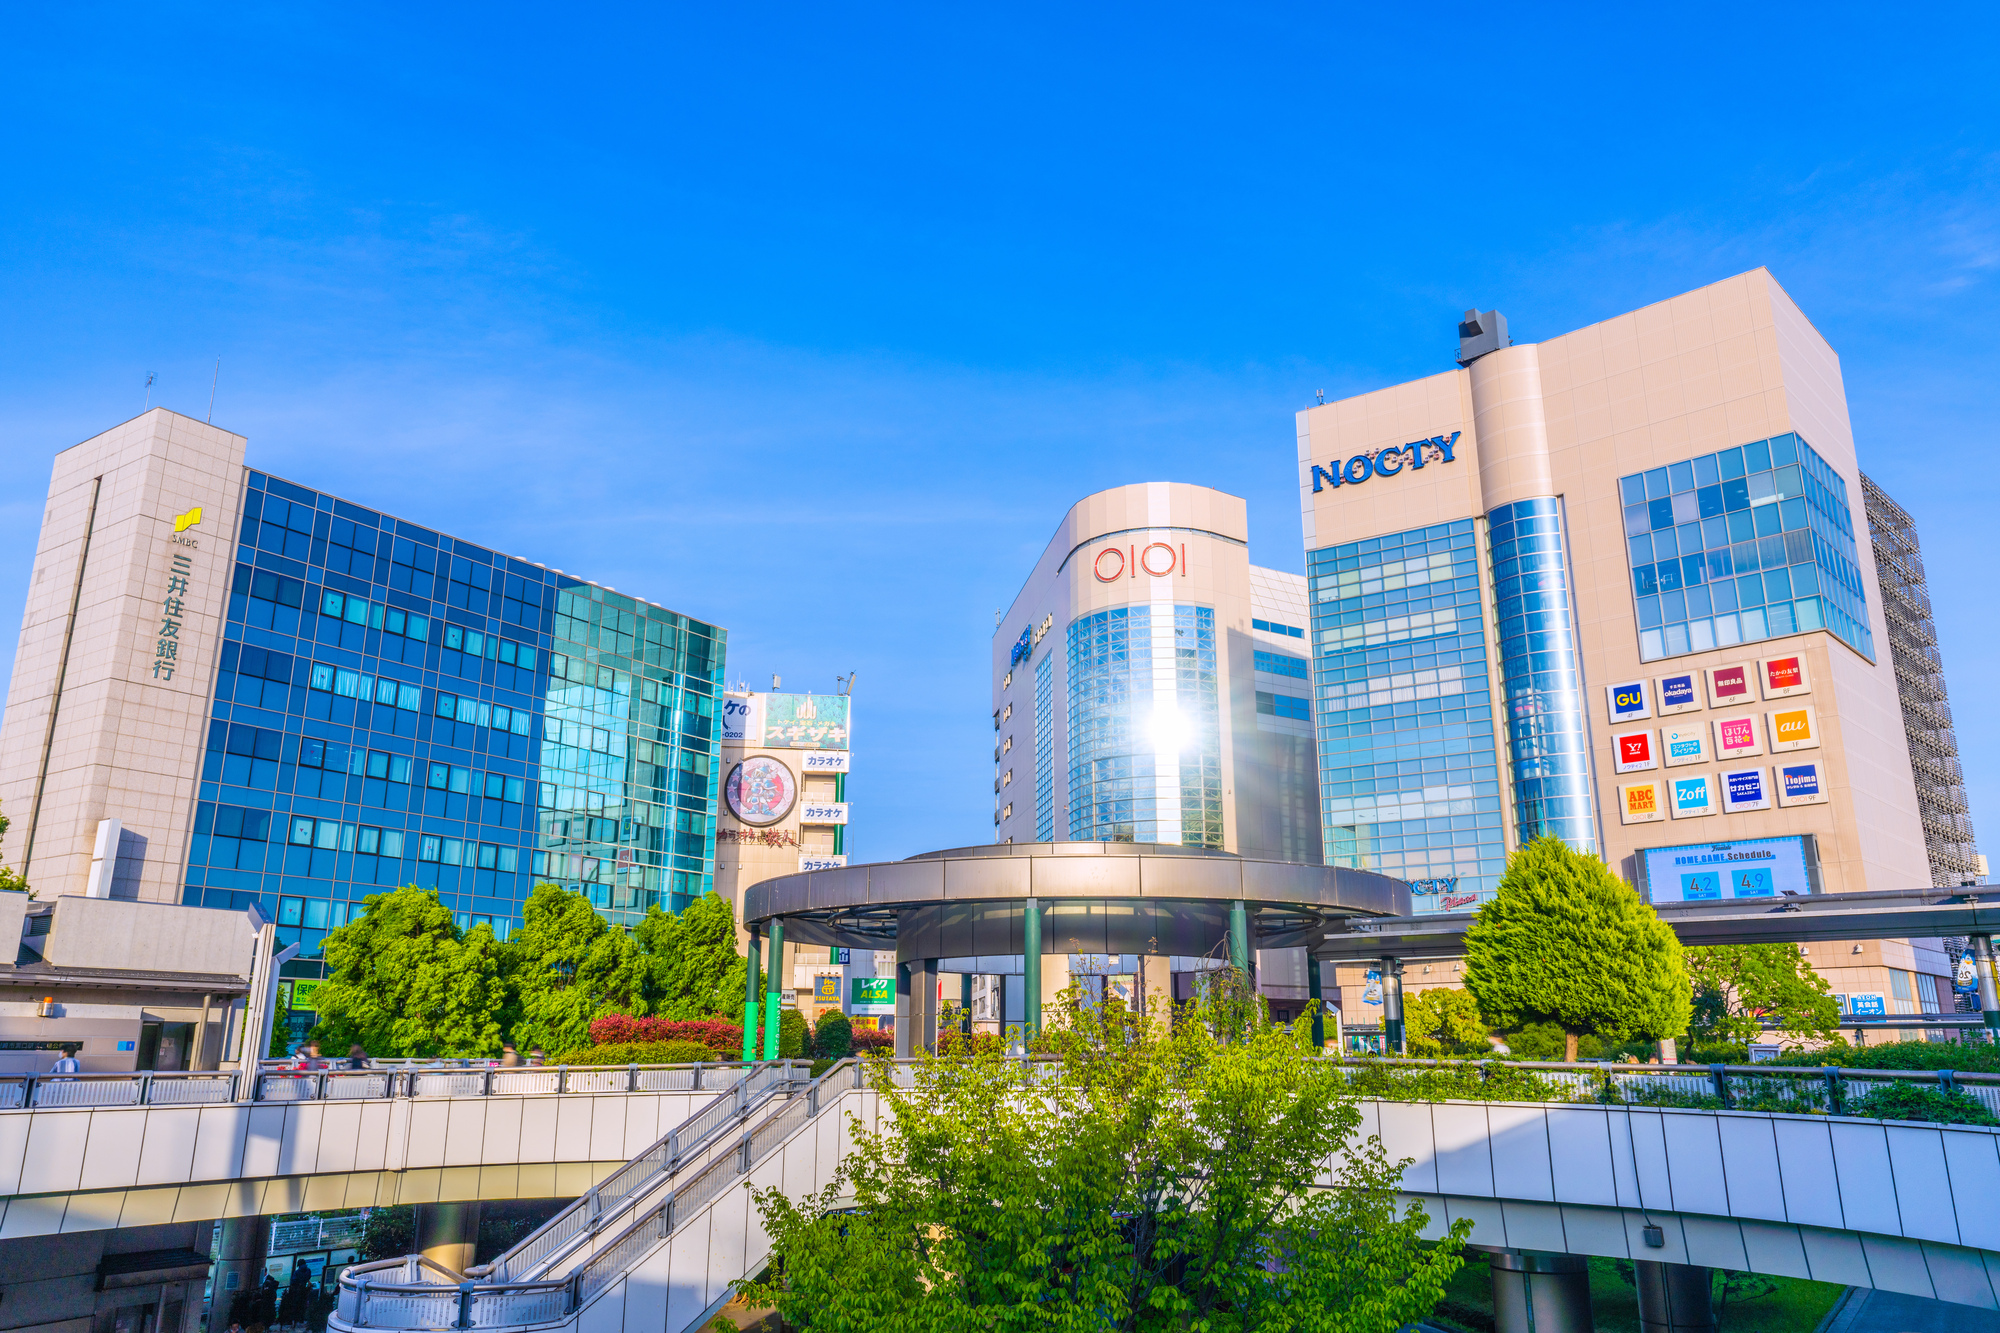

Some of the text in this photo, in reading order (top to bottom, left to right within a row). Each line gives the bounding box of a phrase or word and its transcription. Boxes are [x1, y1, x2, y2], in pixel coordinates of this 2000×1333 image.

[1311, 431, 1462, 492] NOCTY
[171, 534, 199, 549] SMBC
[152, 554, 192, 681] 三井住友銀行
[1717, 677, 1743, 687] 無印良品
[1616, 691, 1641, 706] GU
[1664, 688, 1692, 698] okadaya
[1724, 726, 1749, 736] ほけん
[1780, 720, 1806, 732] au
[766, 725, 847, 743] スギザキ
[1725, 735, 1743, 745] 百花
[1626, 743, 1642, 752] Y!
[807, 756, 844, 766] カラオケ
[1785, 774, 1817, 786] nojima
[1730, 782, 1760, 792] サカゼン
[1628, 789, 1653, 802] ABC
[1678, 786, 1706, 801] Zoff
[1629, 800, 1654, 811] MART
[806, 808, 842, 817] カラオケ
[1675, 849, 1772, 865] HOME GAME Schedule
[1690, 876, 1713, 892] 4.2
[1741, 873, 1764, 888] 4.9
[861, 979, 888, 989] レイク
[860, 989, 888, 999] ALSA
[1857, 1001, 1879, 1009] 英会話
